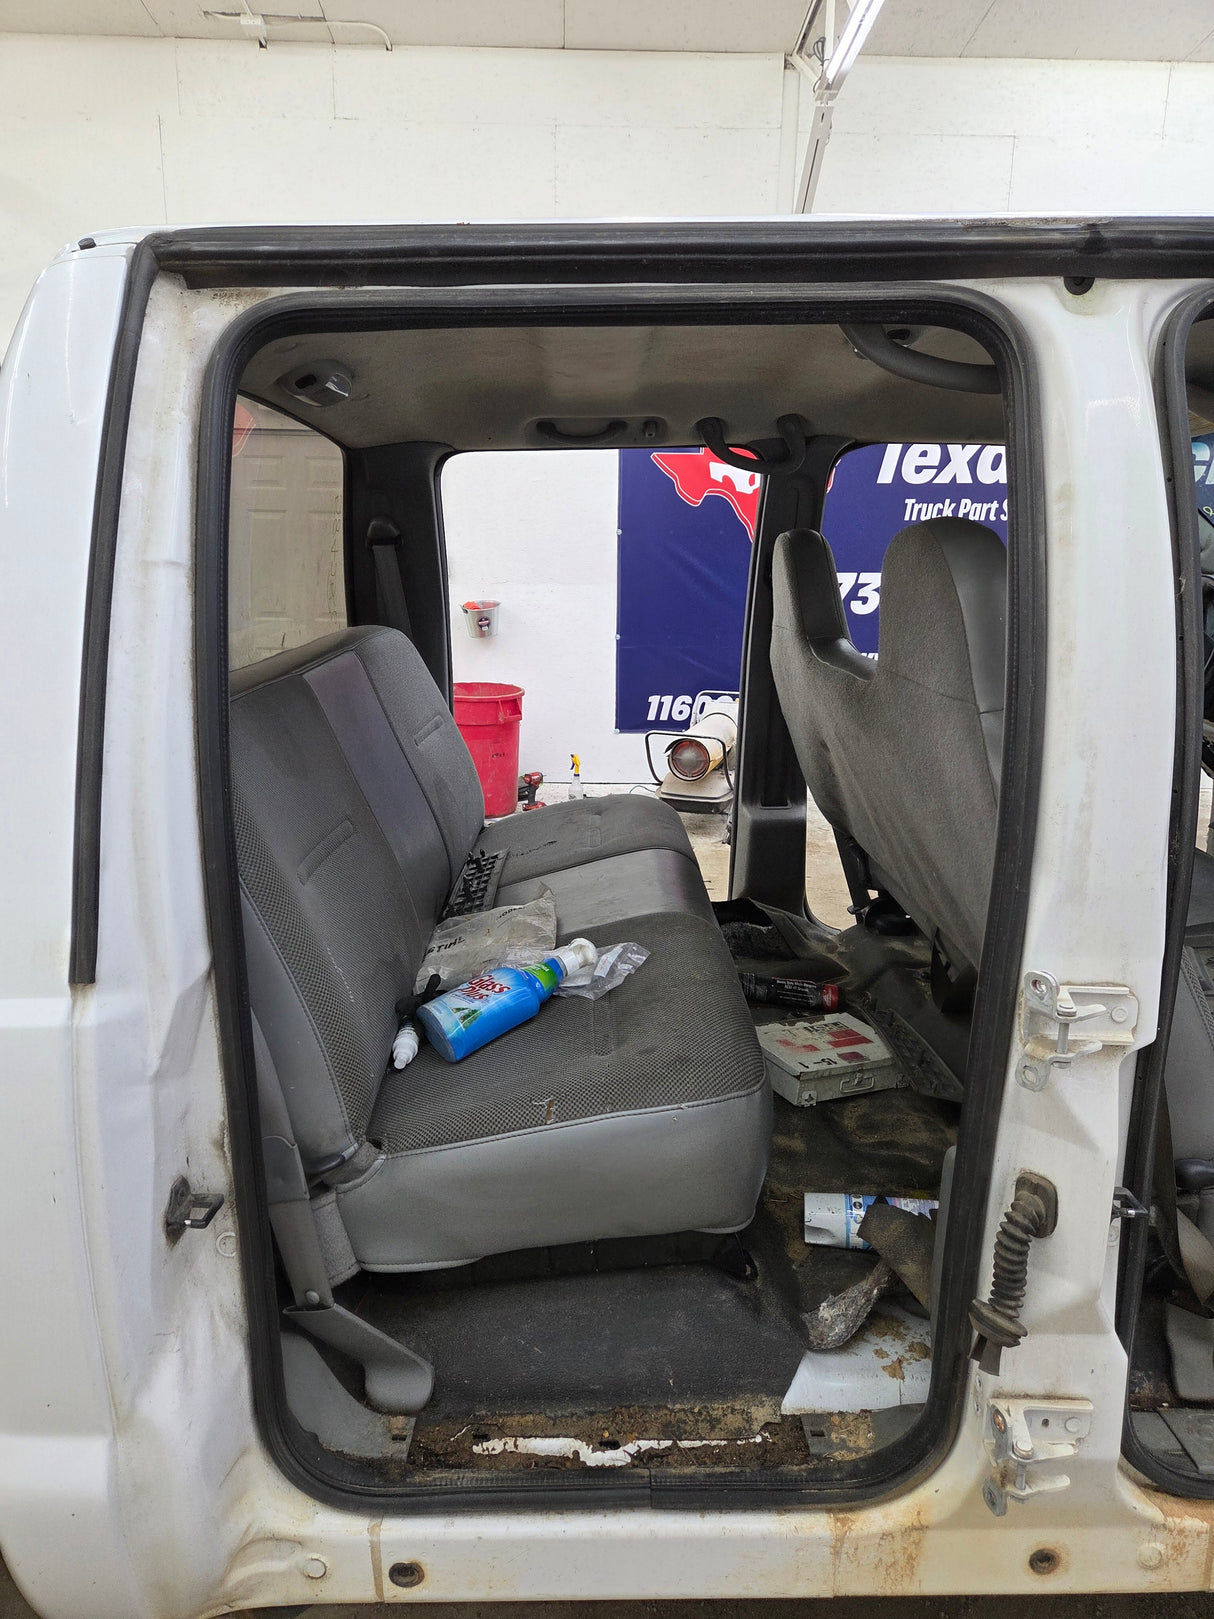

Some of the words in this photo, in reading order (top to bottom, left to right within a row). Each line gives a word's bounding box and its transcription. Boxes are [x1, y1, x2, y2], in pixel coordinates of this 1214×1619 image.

[903, 498, 957, 521] Truck
[957, 498, 999, 521] Part
[426, 935, 466, 955] STIHL
[456, 985, 491, 1001] Plus
[467, 973, 512, 994] Glass
